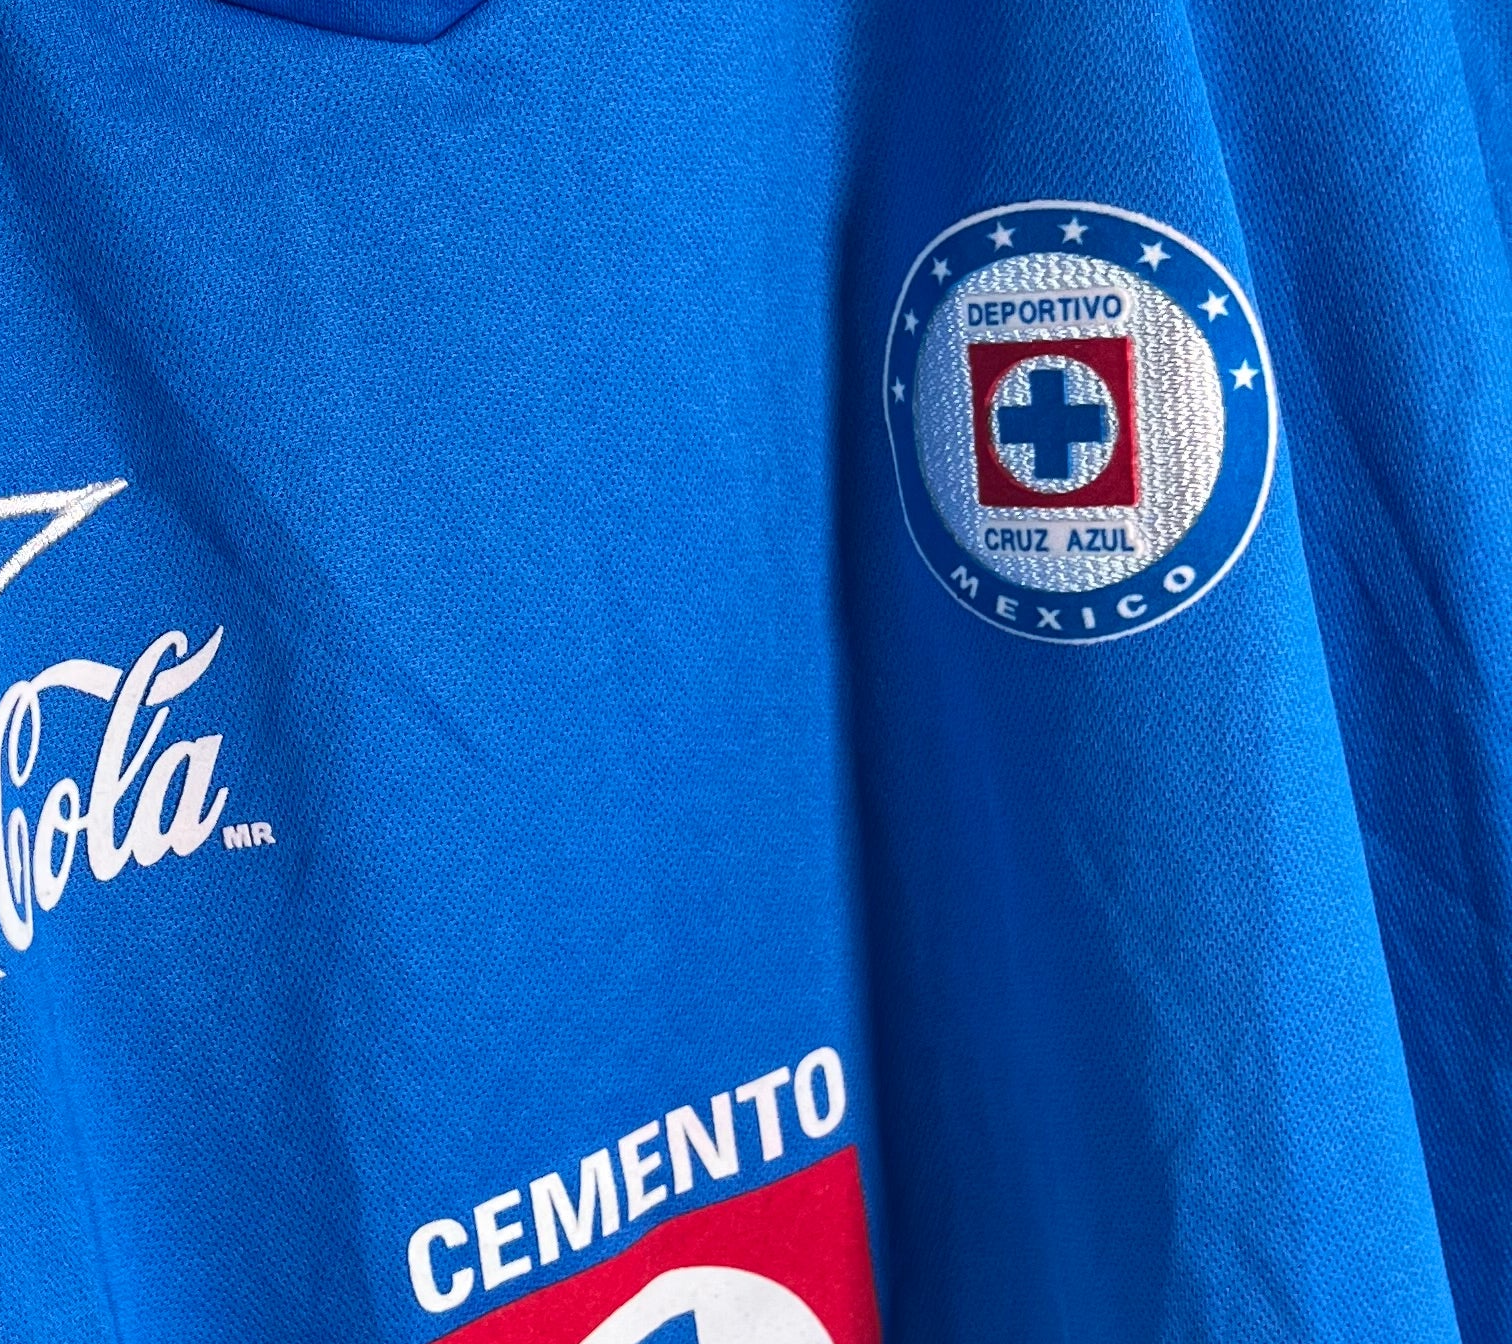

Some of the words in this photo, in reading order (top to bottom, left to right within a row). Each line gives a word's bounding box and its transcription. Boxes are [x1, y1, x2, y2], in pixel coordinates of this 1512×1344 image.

[967, 293, 1123, 327] DEPORTIVO
[983, 527, 1050, 554] CRUZ
[1065, 525, 1136, 553] AZUL
[949, 564, 1197, 631] MEXICO
[222, 821, 277, 851] MR
[406, 1045, 847, 1313] CEMENTO
